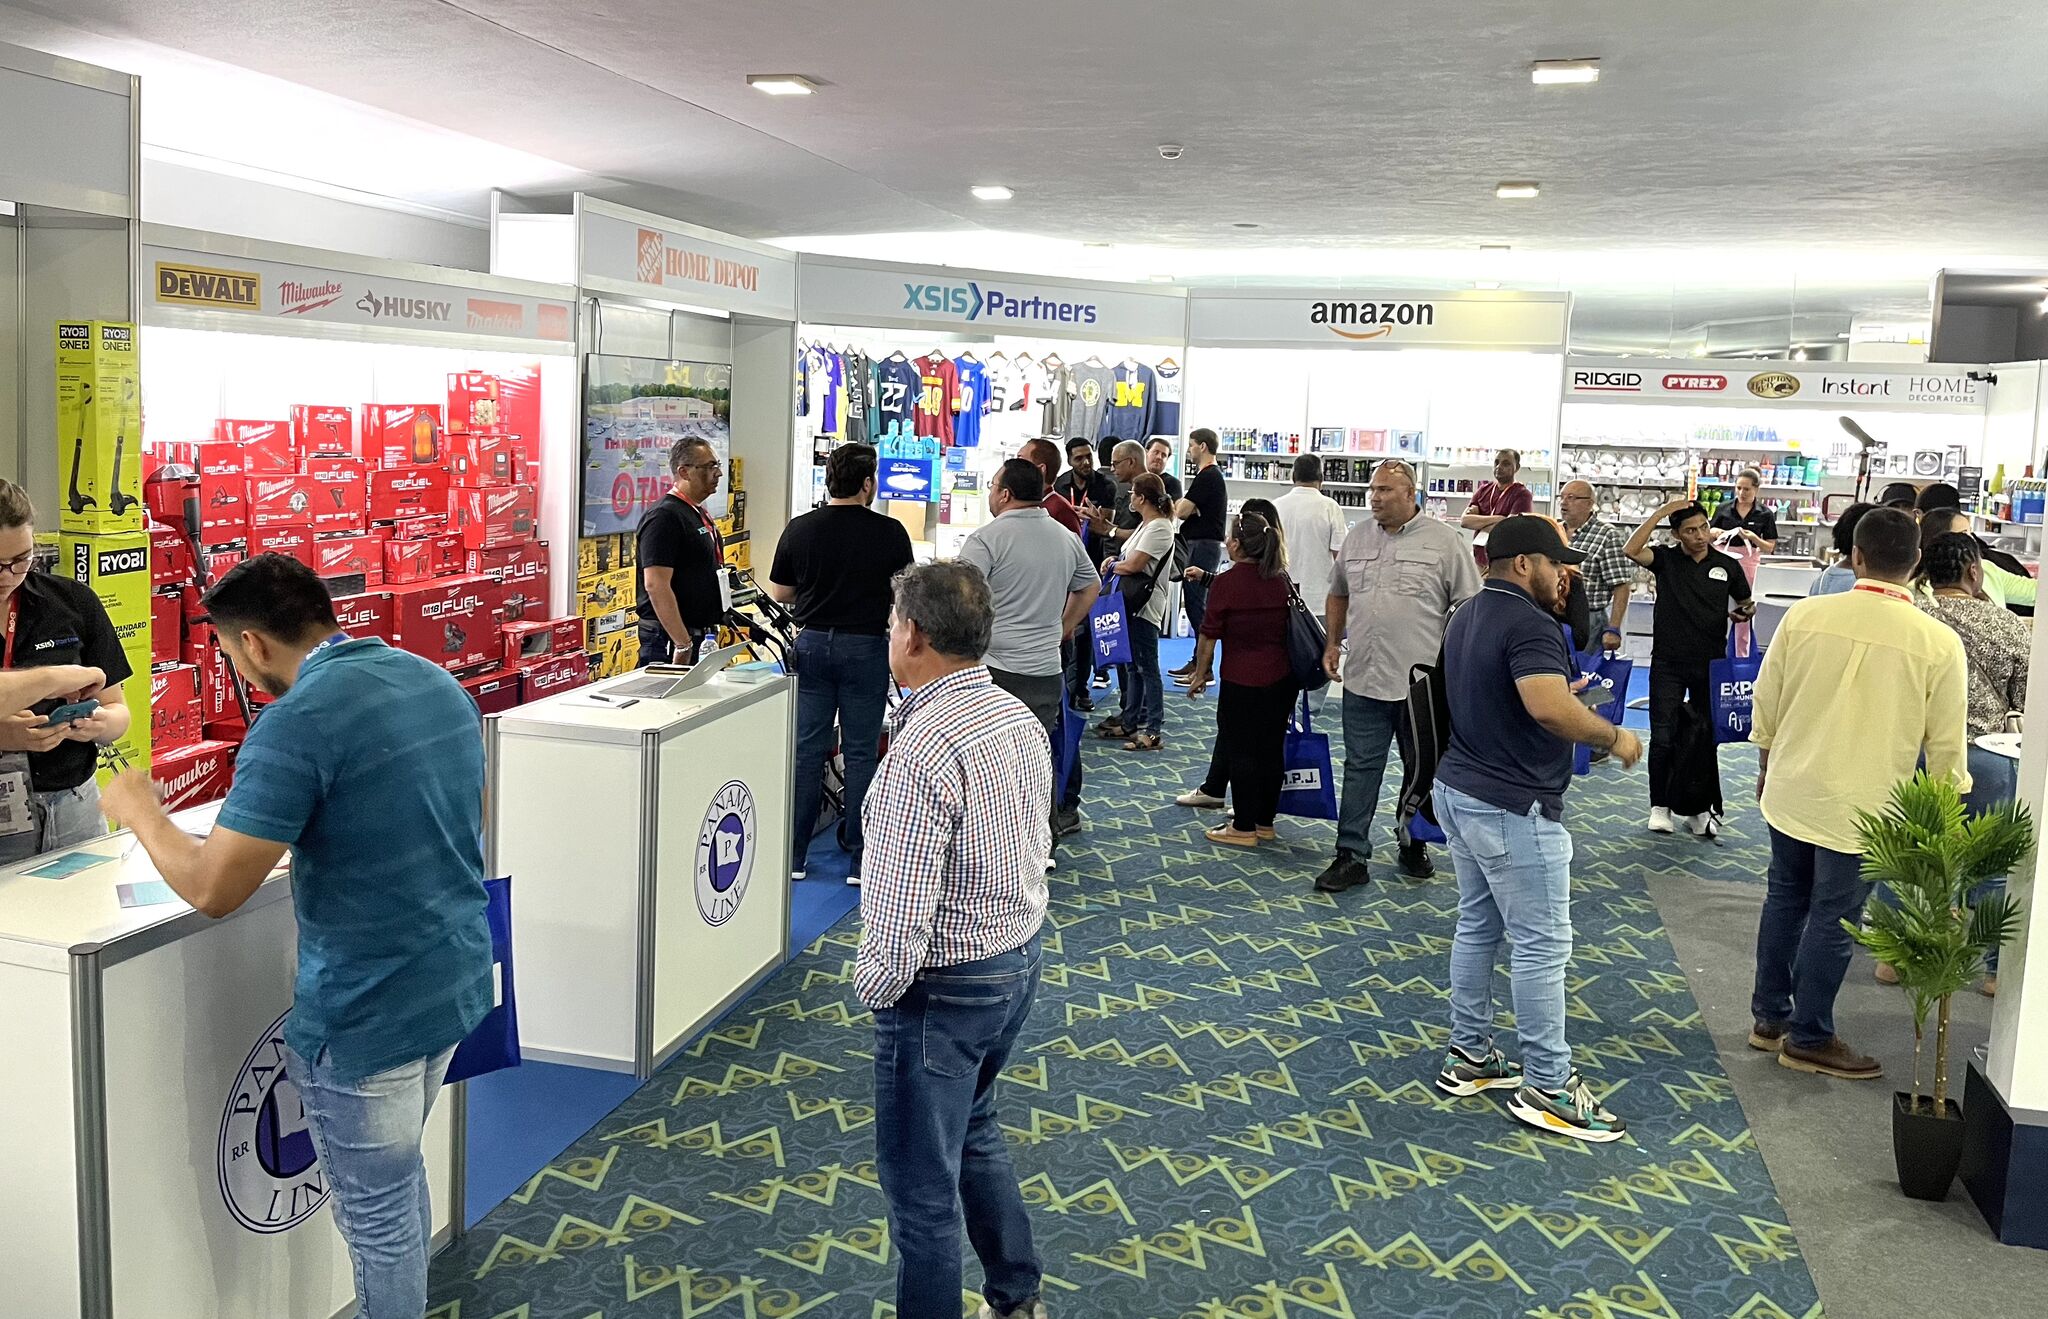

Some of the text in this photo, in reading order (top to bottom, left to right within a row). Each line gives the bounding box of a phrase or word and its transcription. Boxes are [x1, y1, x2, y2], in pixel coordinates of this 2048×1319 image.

[666, 247, 759, 291] HOME DEPOT
[278, 280, 342, 306] Milwaukee
[384, 296, 451, 321] HUSKY
[903, 283, 1096, 324] XSIS Partners
[1310, 302, 1433, 325] amazon
[61, 327, 88, 337] RYOBI
[103, 328, 129, 339] RYOBI
[1574, 372, 1642, 387] RIDGID
[1667, 377, 1720, 389] PYREX
[1822, 377, 1890, 396] Instant
[1910, 376, 1976, 394] HOME
[881, 383, 907, 413] 22
[1115, 381, 1145, 408] M
[1909, 395, 1975, 403] DECORATORS
[328, 470, 359, 479] FUEL
[405, 478, 432, 487] FUEL
[275, 536, 305, 545] FUEL
[76, 545, 87, 583] RYOB
[100, 551, 144, 572] RYOBI
[503, 560, 544, 579] FUEL
[442, 595, 484, 613] FUEL
[336, 609, 380, 624] FUEL
[115, 621, 147, 633] TANDARD
[547, 667, 577, 683] FUEL
[1720, 681, 1752, 696] EXP
[160, 757, 218, 799] lwaukee
[1283, 771, 1317, 786] .P.J.
[700, 788, 752, 847] PANAMA
[711, 880, 743, 919] LINE
[232, 1037, 286, 1117] PAN
[232, 1141, 250, 1162] RR
[264, 1169, 324, 1222] LIN
